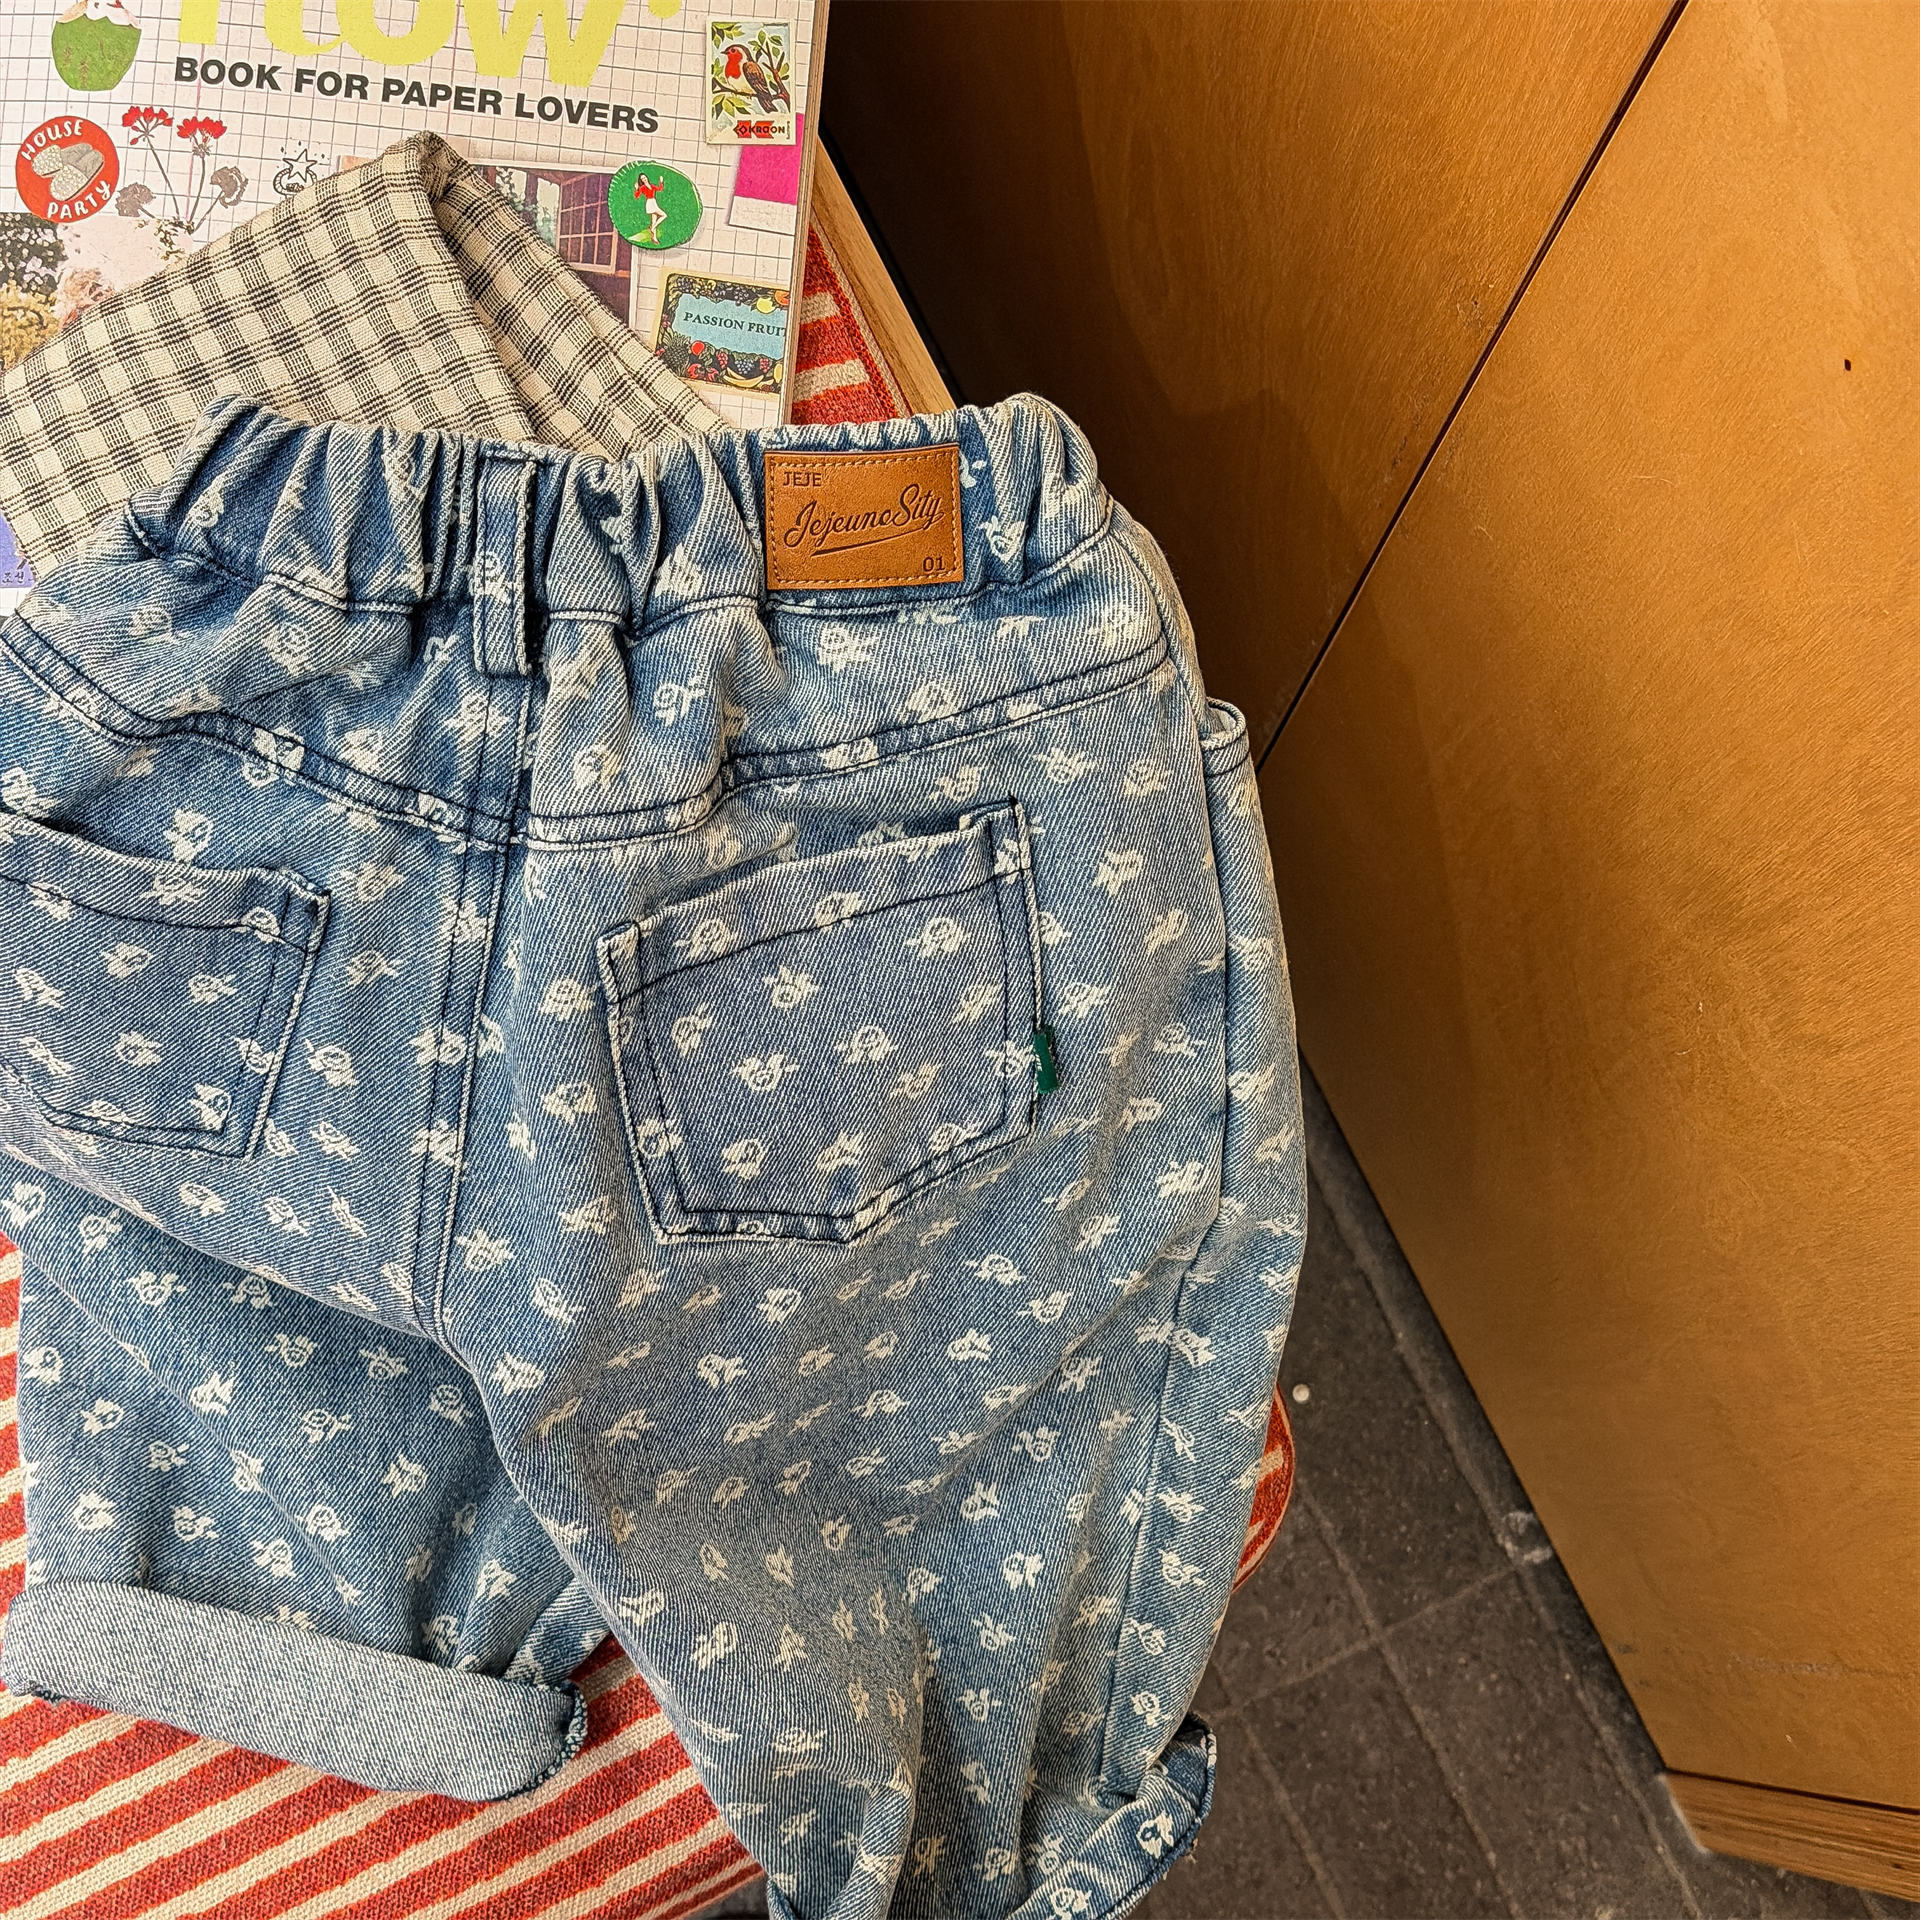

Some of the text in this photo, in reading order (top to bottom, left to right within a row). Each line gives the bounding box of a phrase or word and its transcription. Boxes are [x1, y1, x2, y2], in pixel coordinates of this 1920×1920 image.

[174, 56, 659, 133] BOOK FOR PAPER LOVERS
[21, 119, 84, 161] HOUSE
[47, 180, 111, 219] PARTY
[683, 311, 787, 337] PASSION FRUIT
[782, 471, 822, 487] JEJE
[922, 556, 946, 572] 01
